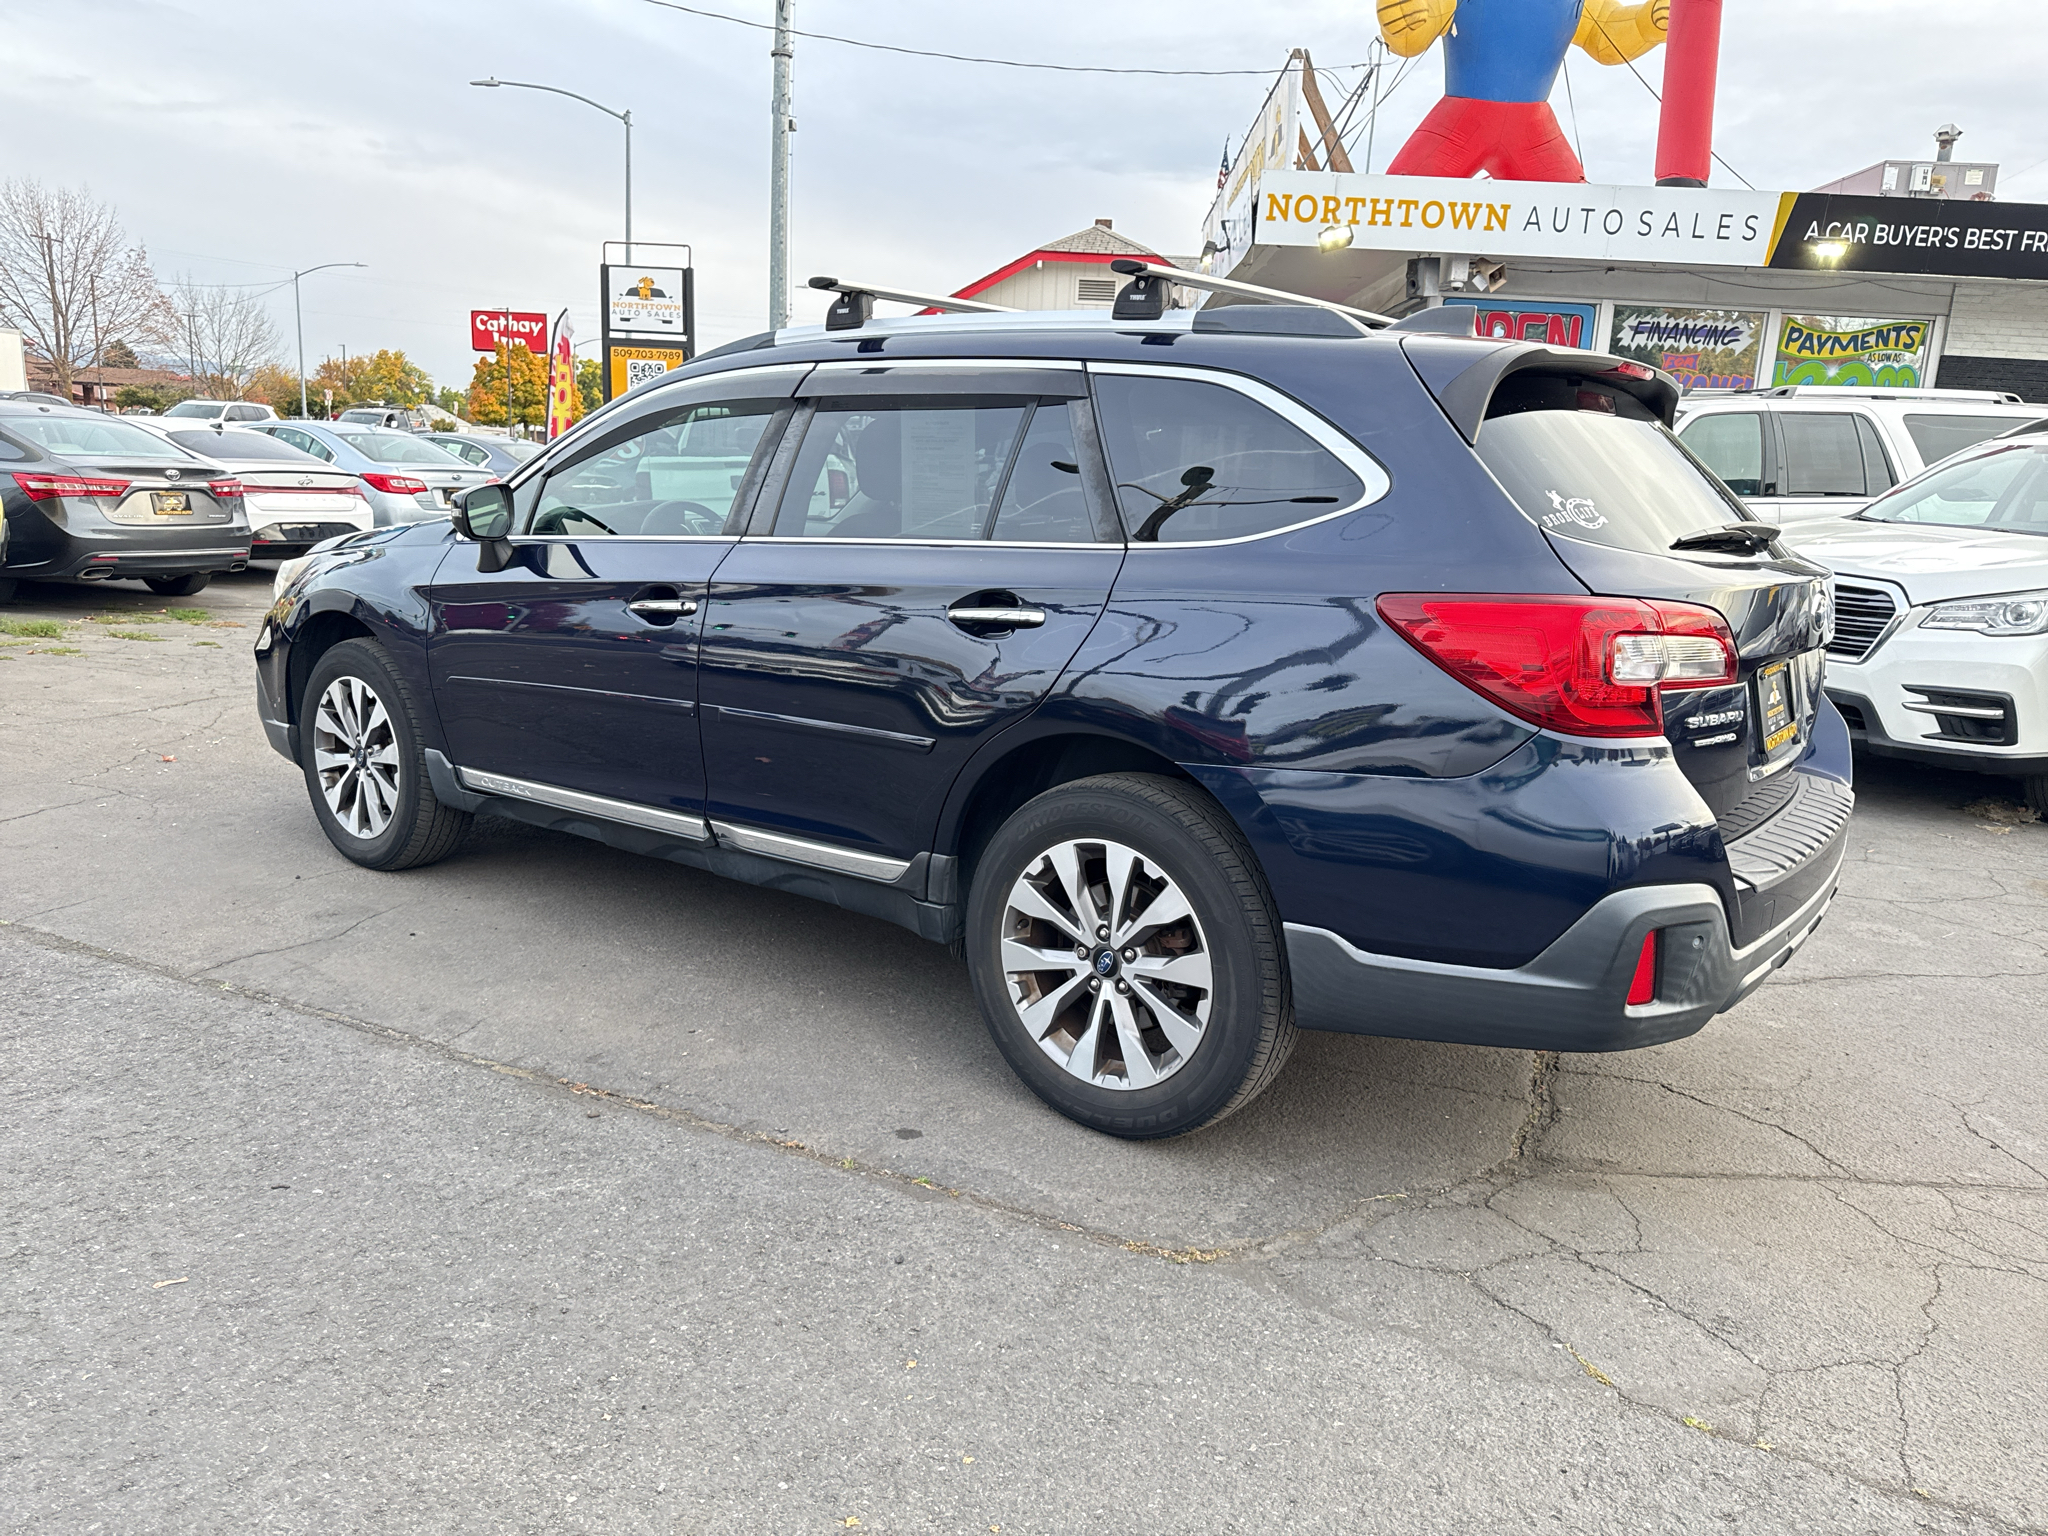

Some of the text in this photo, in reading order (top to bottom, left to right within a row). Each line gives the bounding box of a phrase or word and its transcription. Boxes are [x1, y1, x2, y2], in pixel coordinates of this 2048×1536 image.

[1266, 193, 1759, 242] NORTHTOWN AUTO SALES
[1803, 220, 1819, 241] A
[1825, 221, 1869, 244] CAR
[1873, 224, 1960, 249] BUYER'S
[1963, 229, 2018, 251] BEST
[612, 301, 681, 312] NORTHTOWN
[612, 309, 681, 319] AUTO SALES
[476, 315, 543, 336] Cathay
[1631, 320, 1741, 346] FINANCING
[1785, 325, 1921, 356] PAYMENTS
[1665, 356, 1695, 368] FOR
[1867, 352, 1902, 363] AS LOW AS
[1684, 710, 1744, 729] SUBARU
[481, 777, 531, 796] OUTBACK
[1016, 802, 1158, 839] BRIDGESTONE
